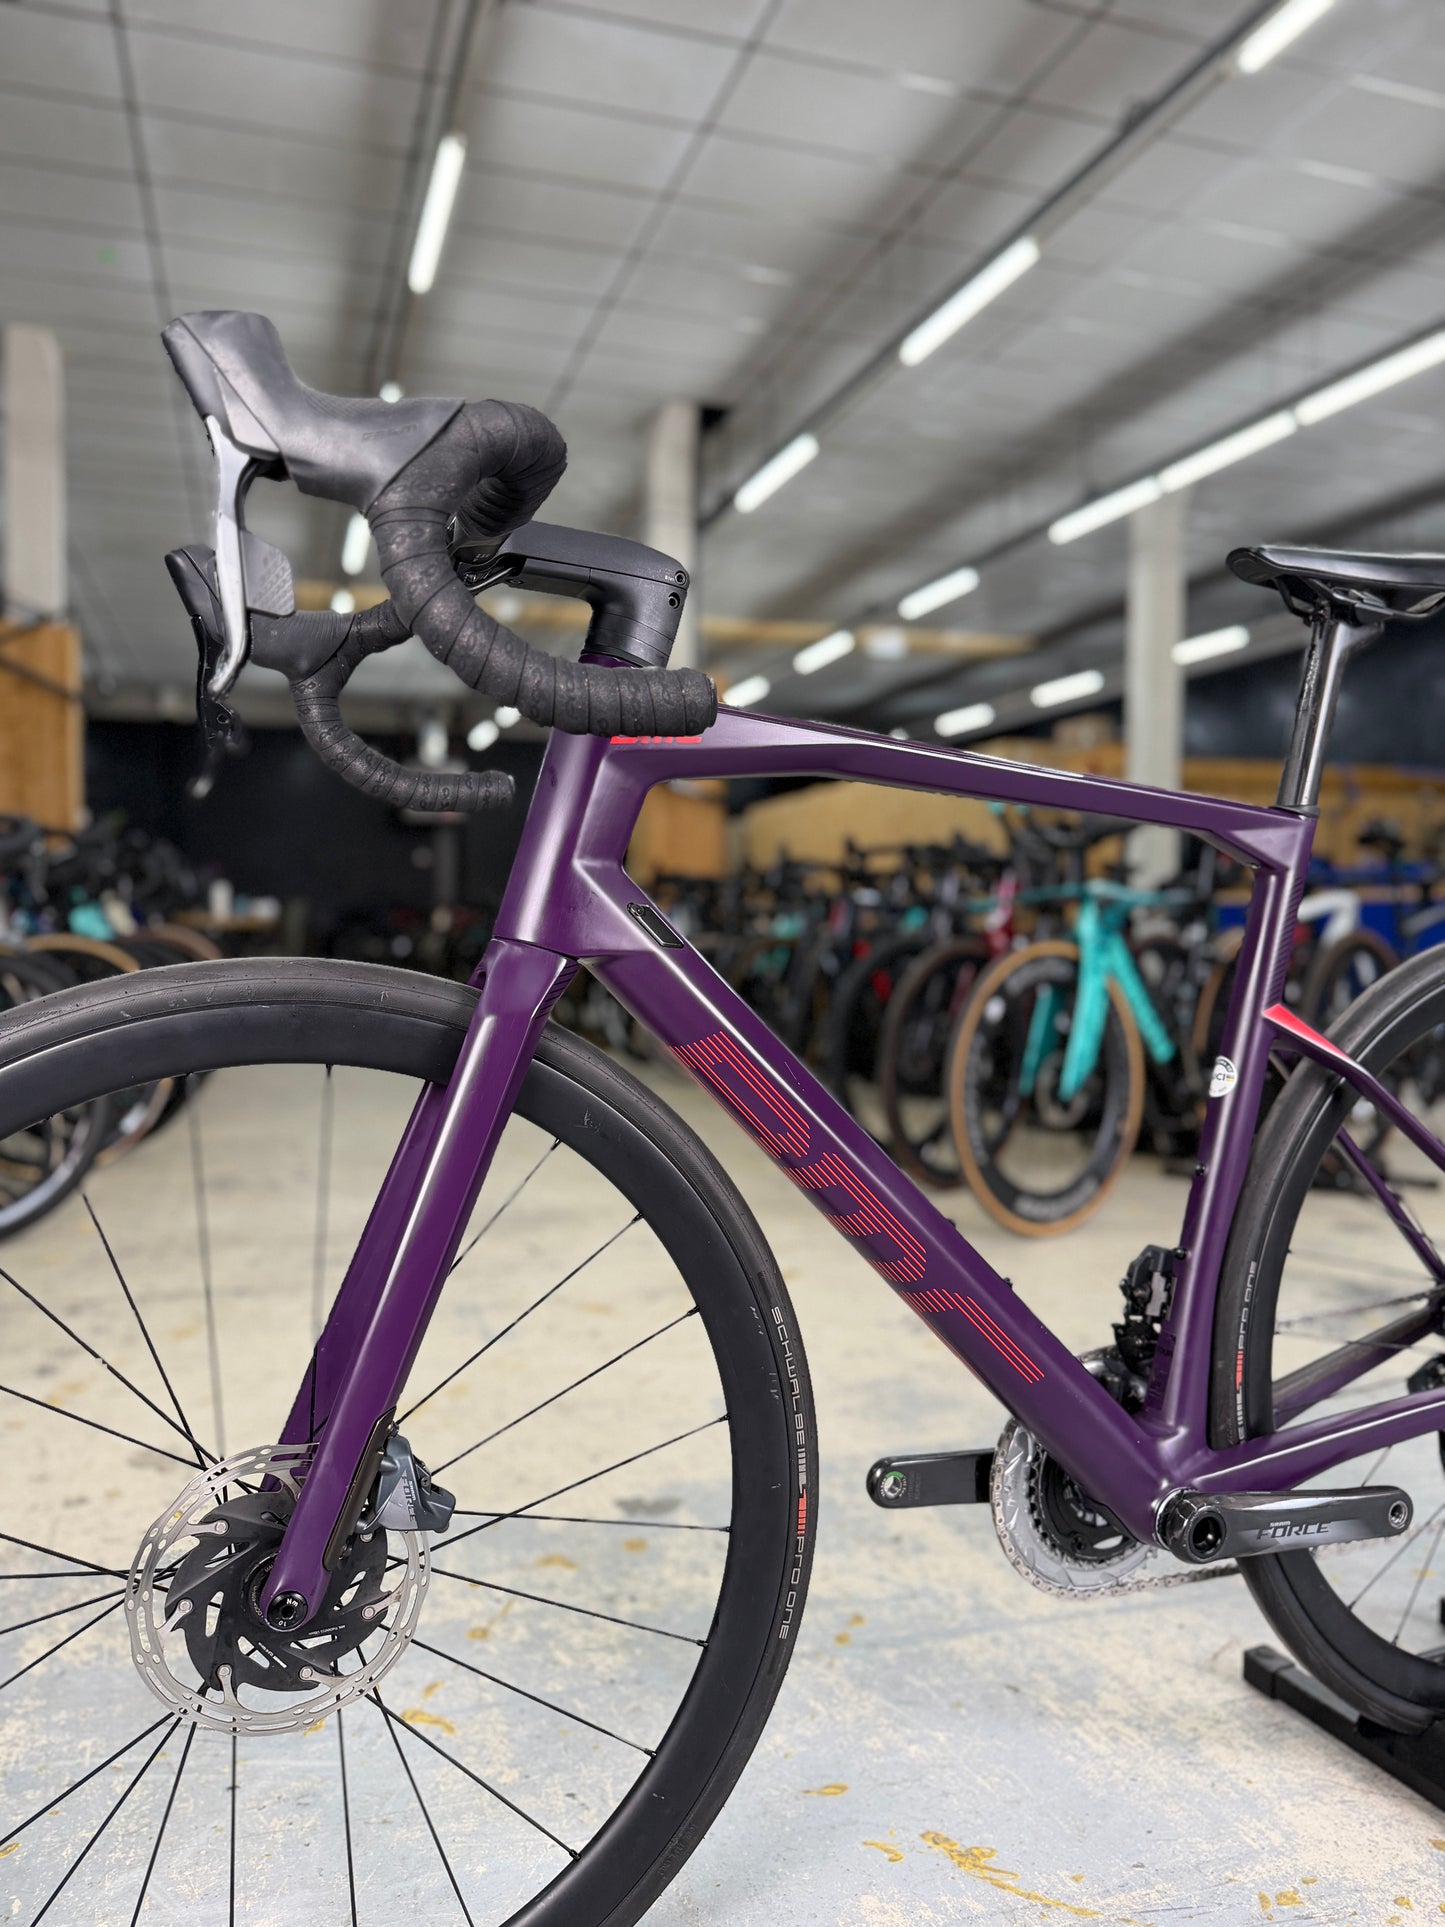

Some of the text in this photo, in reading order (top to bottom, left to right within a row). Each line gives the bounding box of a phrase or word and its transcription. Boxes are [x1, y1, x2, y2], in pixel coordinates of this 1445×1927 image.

[771, 1306, 805, 1446] SCHWALBE
[402, 1477, 416, 1522] FORCE
[1256, 1521, 1330, 1541] FORCE
[286, 1598, 299, 1608] Nm
[778, 1536, 805, 1640] PRO ONE
